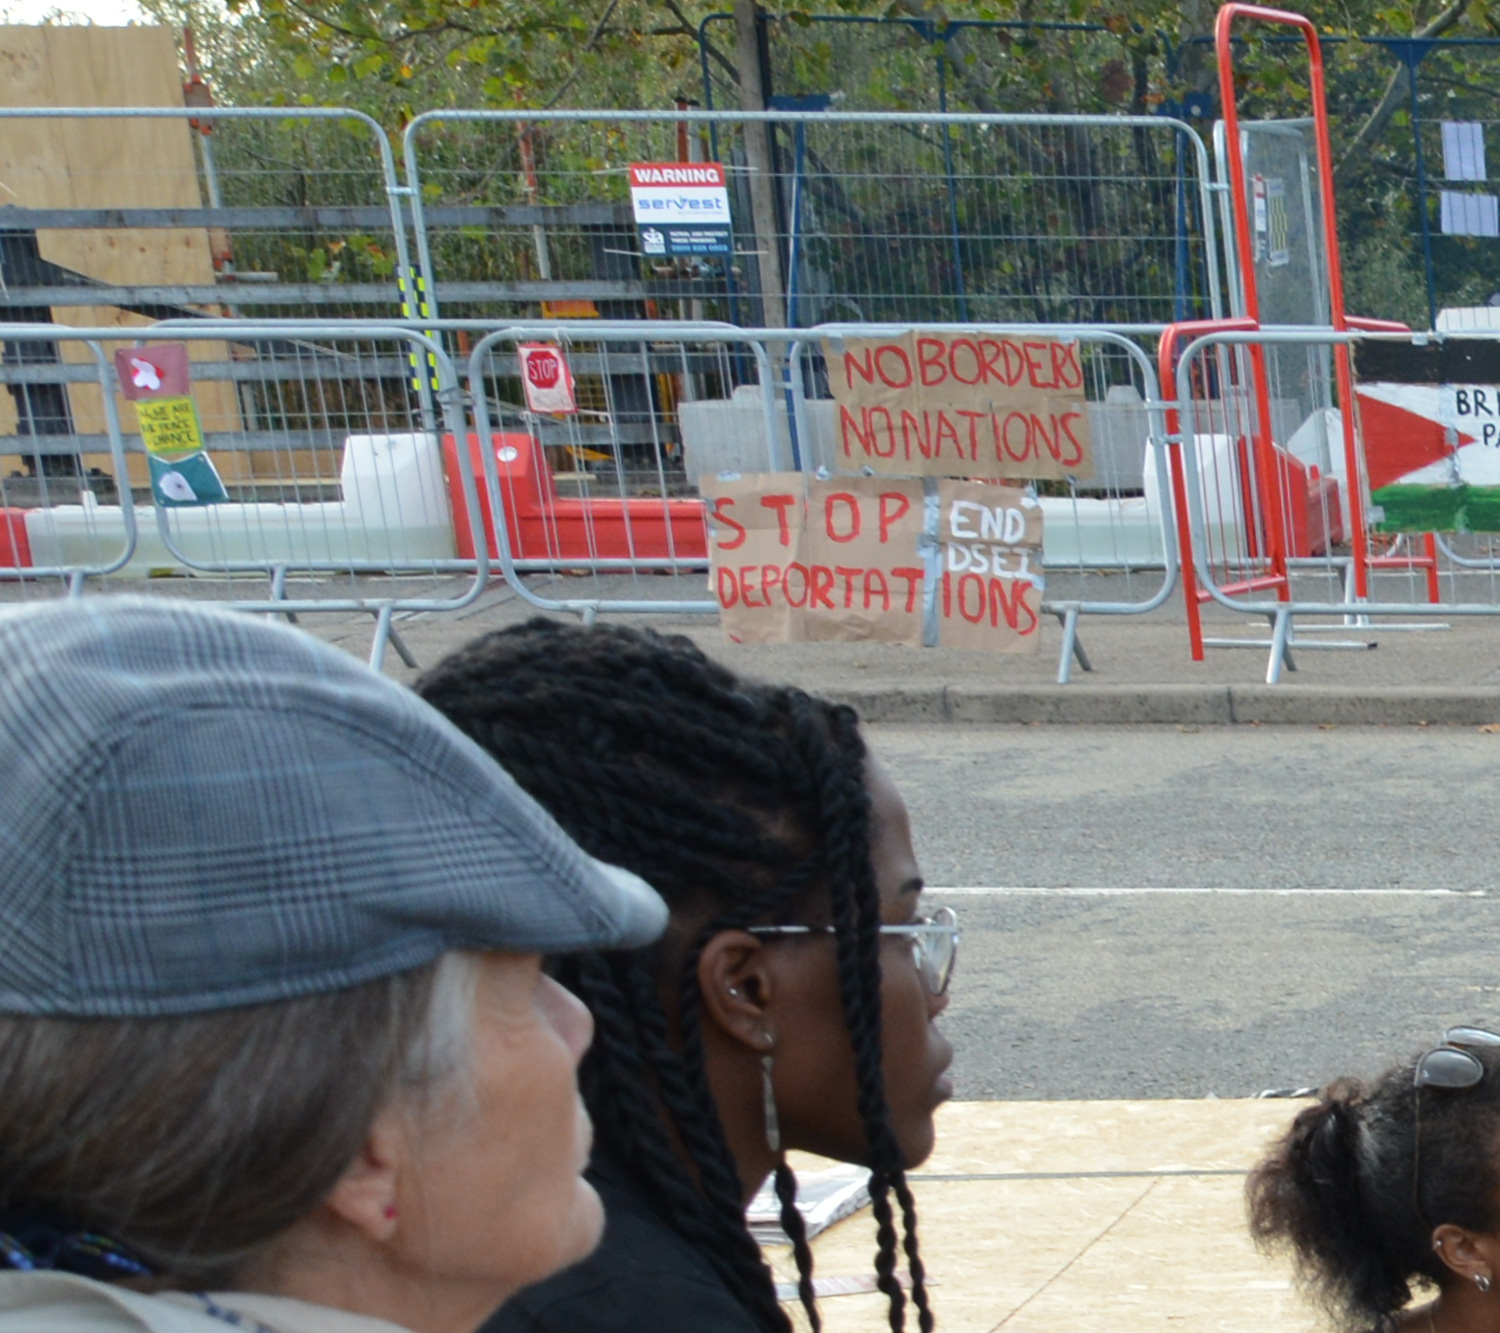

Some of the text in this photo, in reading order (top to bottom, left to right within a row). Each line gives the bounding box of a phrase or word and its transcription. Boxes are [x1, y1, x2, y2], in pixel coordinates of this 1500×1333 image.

[634, 168, 719, 183] WARNING
[638, 197, 722, 210] servest
[528, 358, 557, 380] STOP
[844, 338, 1083, 389] NO BORDERS
[840, 404, 1084, 466] NO NATIONS
[712, 491, 910, 550] STOP
[950, 501, 1025, 543] END
[946, 542, 1035, 579] DSEI
[717, 562, 1038, 635] DEPORTATIONS
